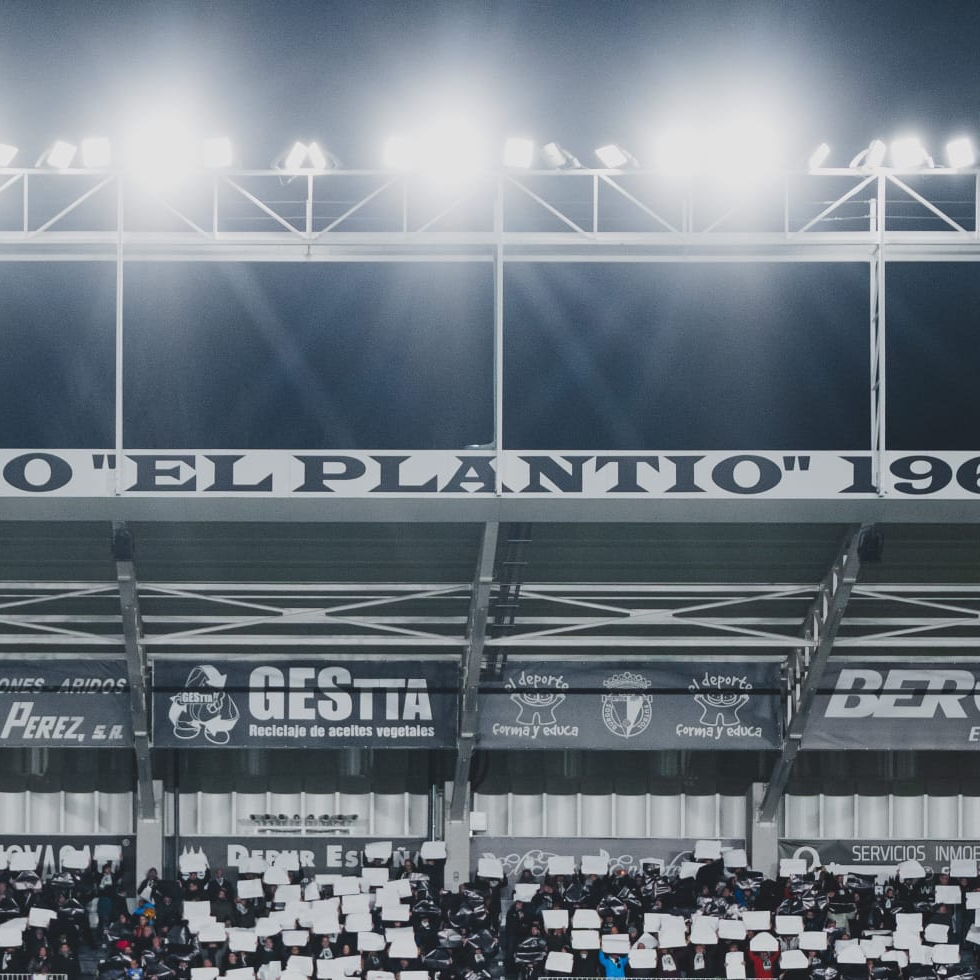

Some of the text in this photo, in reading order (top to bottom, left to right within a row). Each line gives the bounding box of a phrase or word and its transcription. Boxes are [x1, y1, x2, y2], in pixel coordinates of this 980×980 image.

[518, 670, 570, 689] deporte
[701, 671, 753, 690] deporte
[248, 666, 433, 721] GESTTA
[824, 668, 980, 719] BER
[248, 724, 435, 739] Reciclaje de aceites vegetales
[492, 722, 579, 739] forma y educa
[675, 723, 763, 740] forma y educa
[852, 845, 926, 862] SERVICIOS
